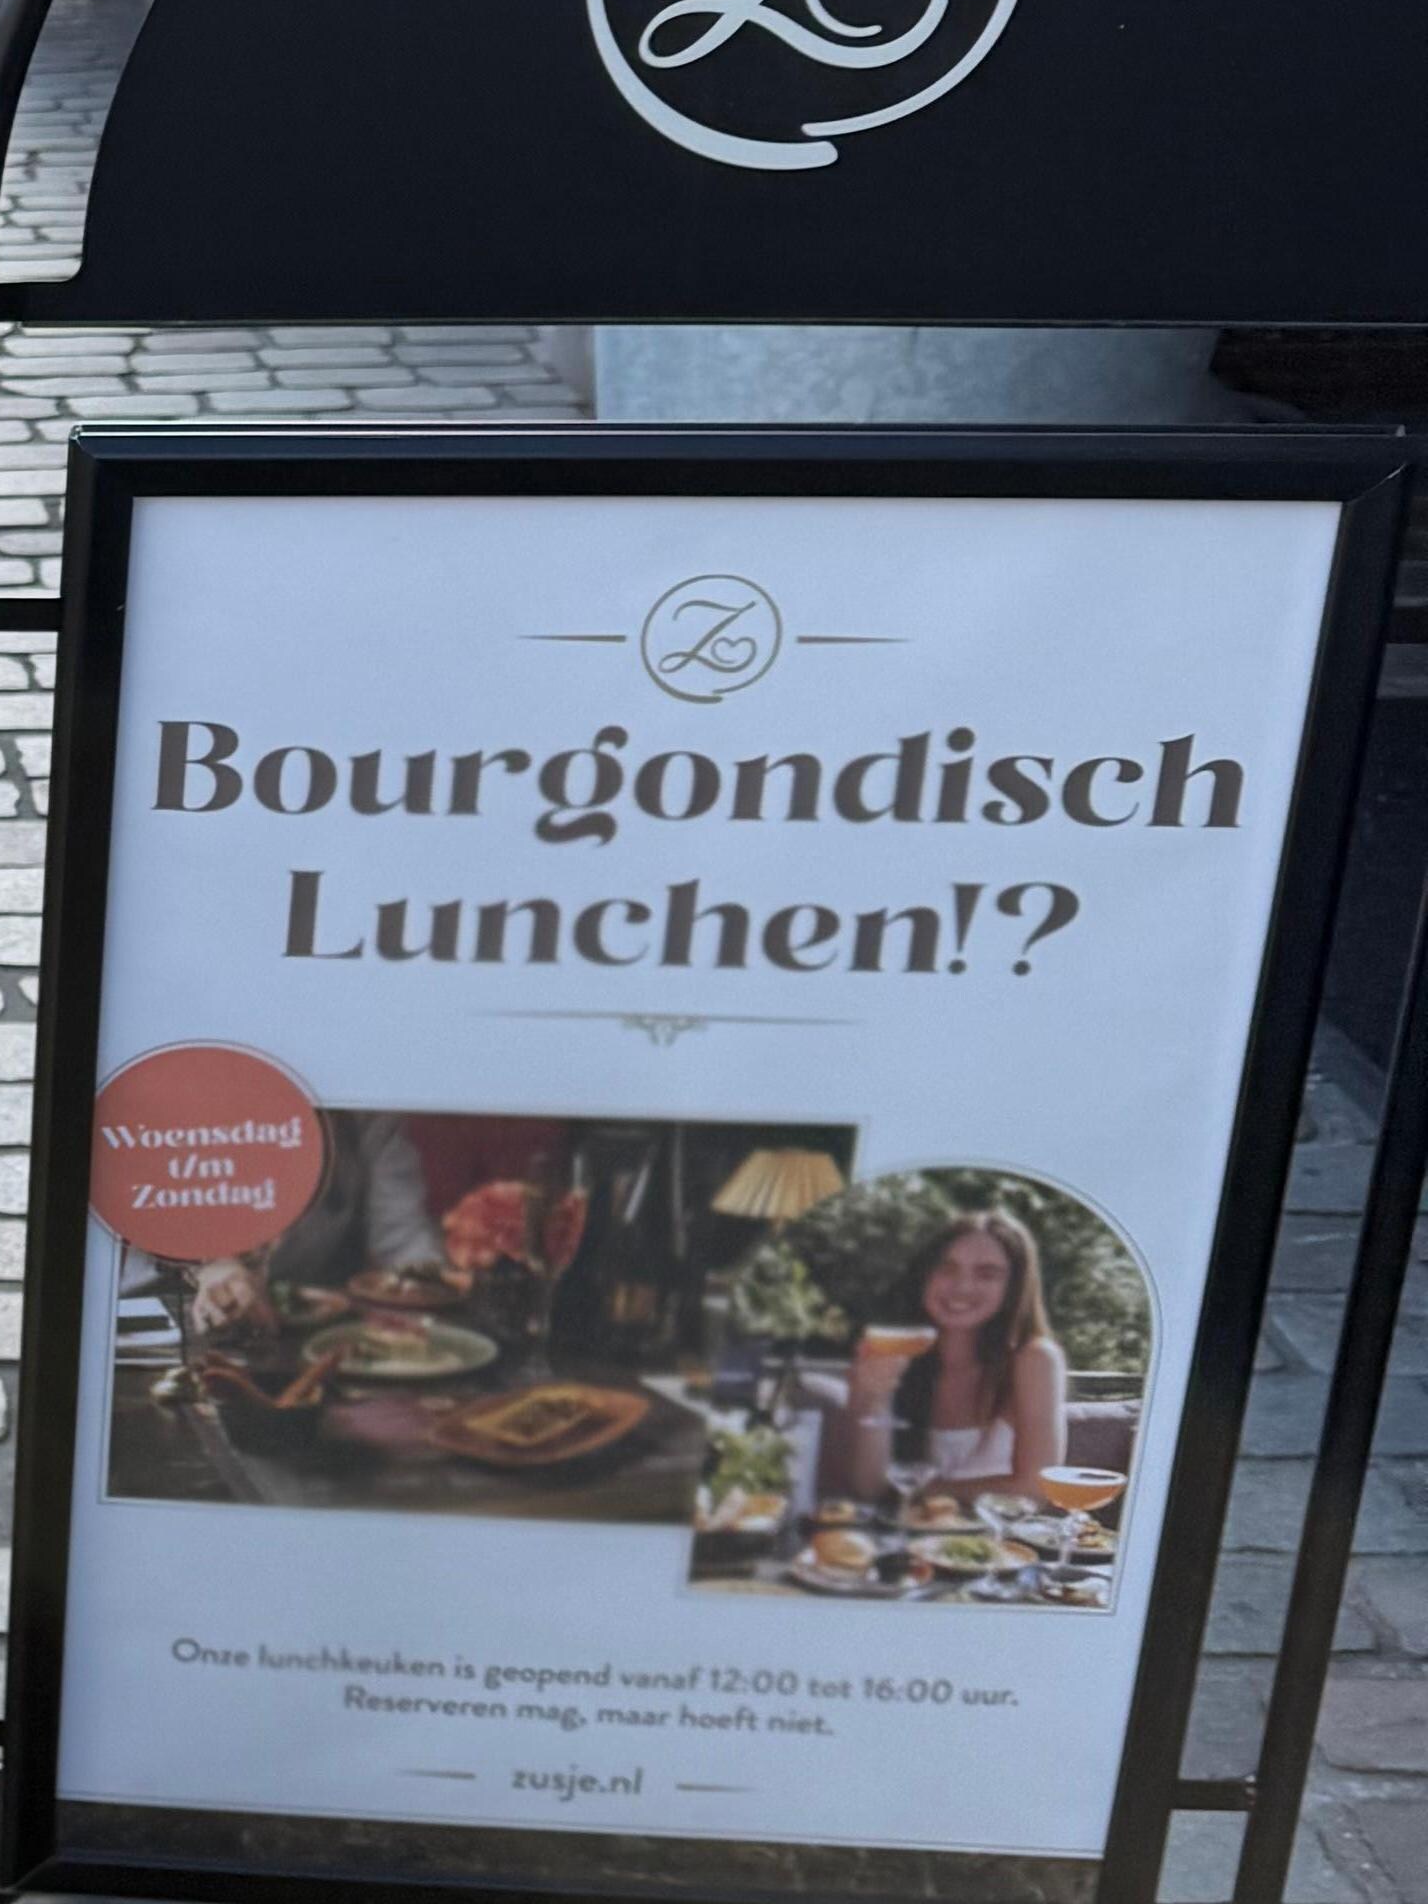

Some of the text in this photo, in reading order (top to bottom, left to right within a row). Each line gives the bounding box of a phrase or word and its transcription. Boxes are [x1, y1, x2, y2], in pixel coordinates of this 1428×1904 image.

[151, 719, 1245, 849] Bourgondisch
[280, 870, 1082, 978] Lunchen!?
[101, 1116, 302, 1150] Woensdag
[167, 1152, 235, 1180] t/m
[130, 1178, 277, 1211] Zondag
[171, 1637, 250, 1667] Onze
[257, 1643, 446, 1677] lunchkeuken
[454, 1655, 477, 1680] is
[483, 1662, 612, 1692] geopend
[620, 1666, 702, 1691] vanaf
[807, 1676, 852, 1699] tot
[961, 1688, 1020, 1708] uur.
[344, 1683, 834, 1738] Reserveren mag, maar hoeft niet.
[511, 1763, 644, 1802] zusje.nl
